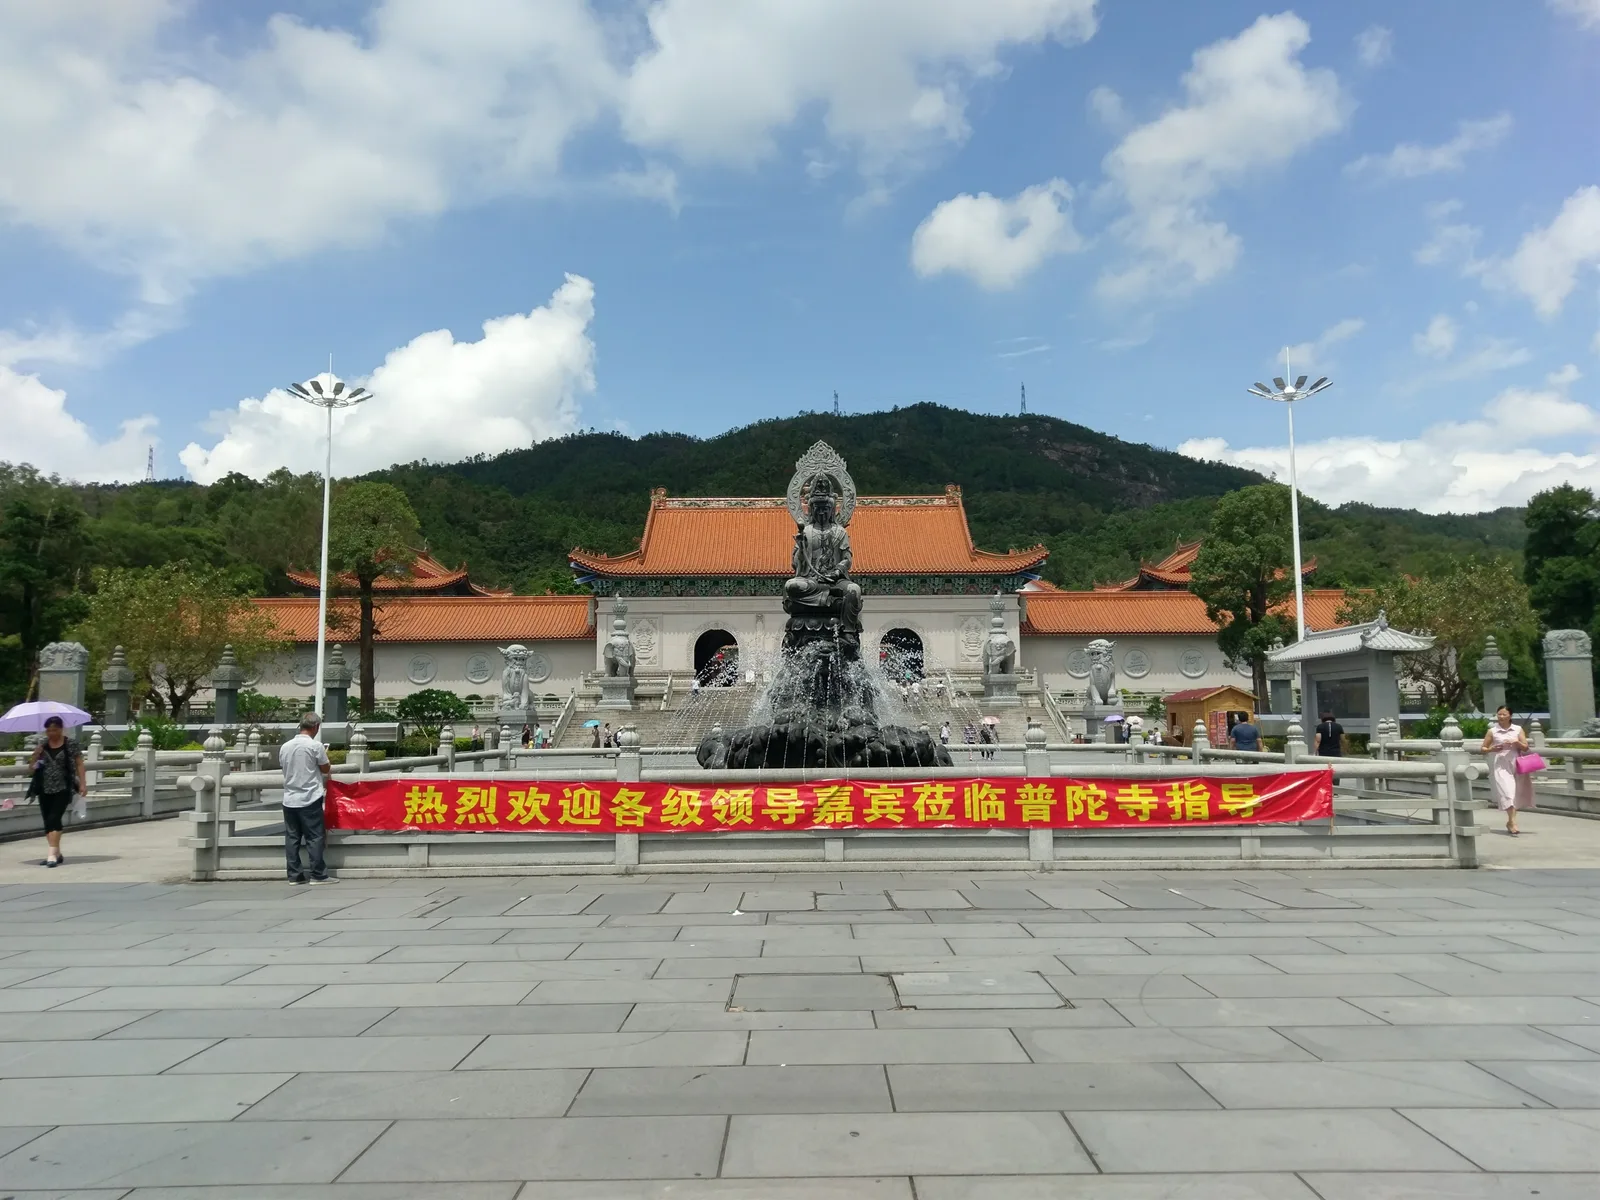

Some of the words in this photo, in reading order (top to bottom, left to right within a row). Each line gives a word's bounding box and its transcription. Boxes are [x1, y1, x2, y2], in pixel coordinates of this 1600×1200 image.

[402, 782, 1263, 827] 热烈欢迎各级领导嘉宾莅临普陀寺指导
